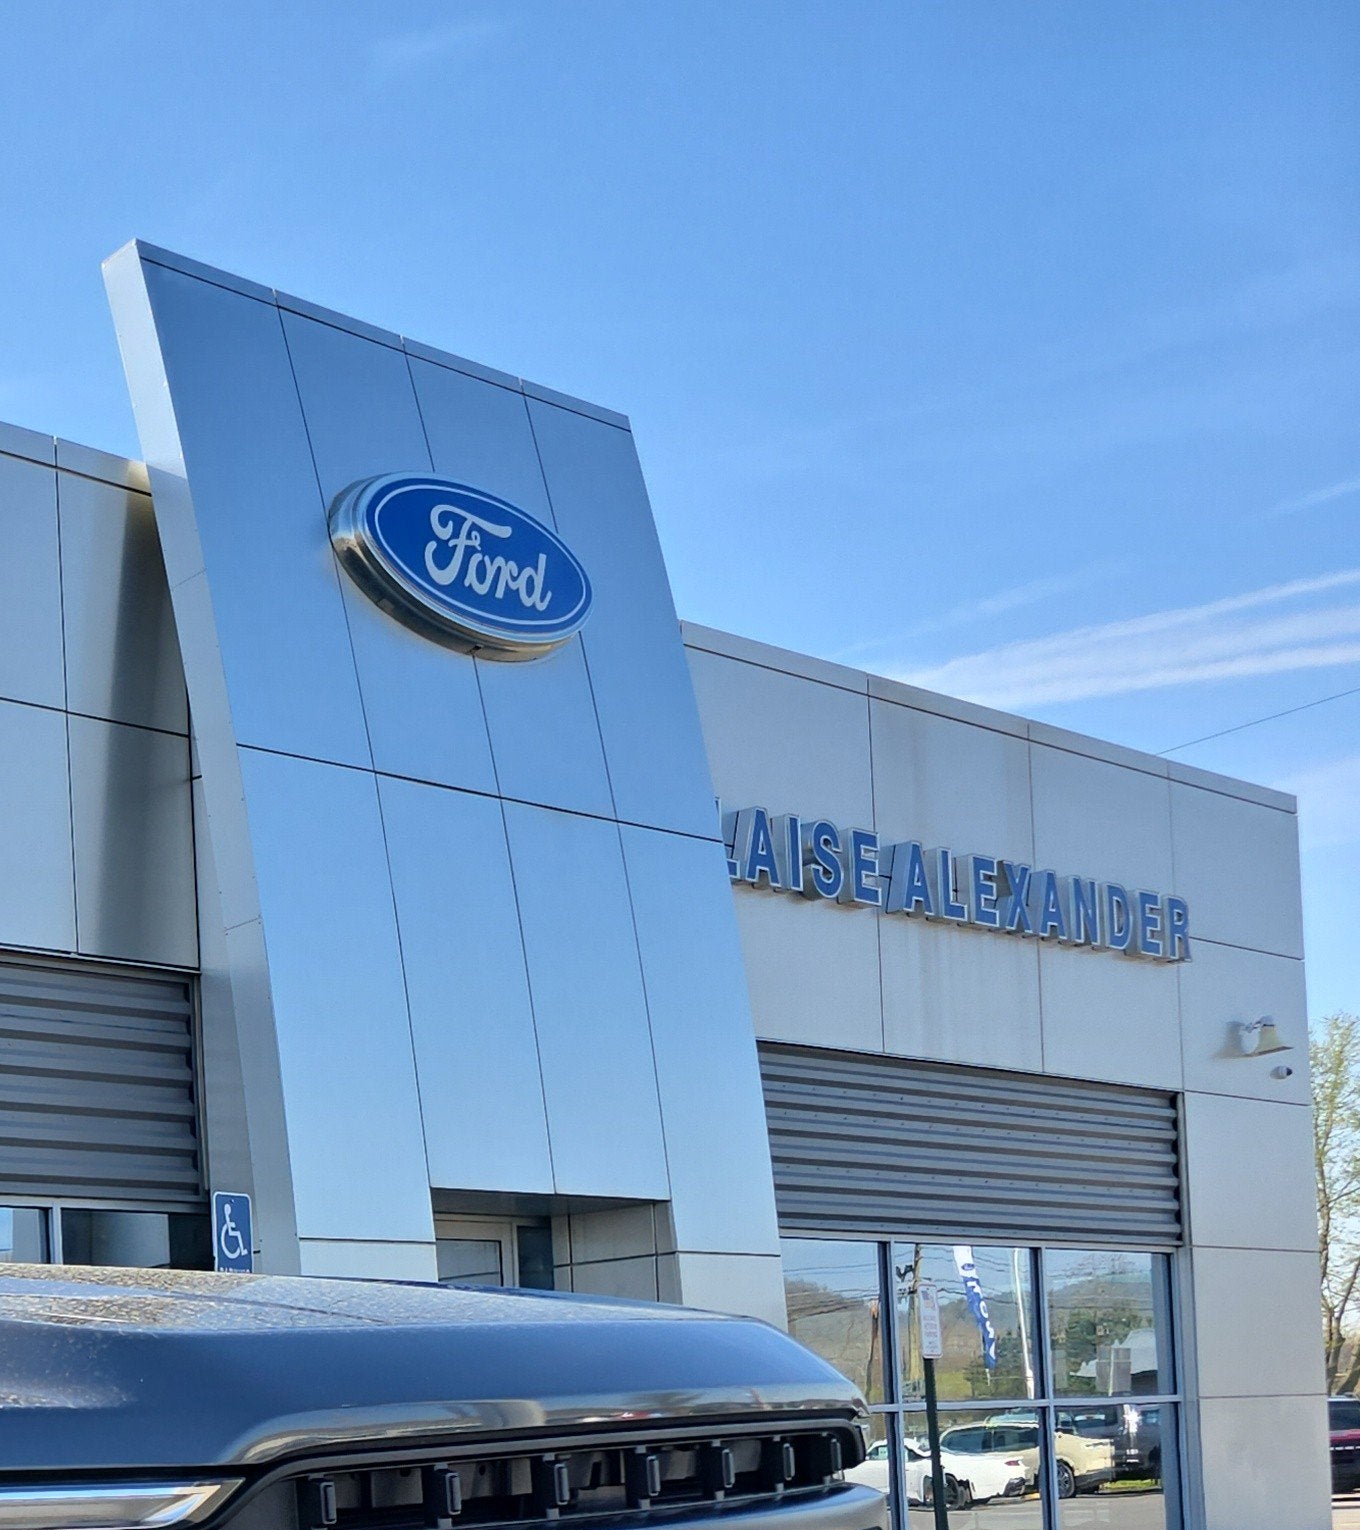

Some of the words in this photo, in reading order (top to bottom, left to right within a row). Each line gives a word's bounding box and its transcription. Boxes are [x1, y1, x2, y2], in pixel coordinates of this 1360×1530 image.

[424, 504, 552, 612] Ford
[727, 807, 882, 906] AISE
[901, 840, 1193, 963] ALEXANDER
